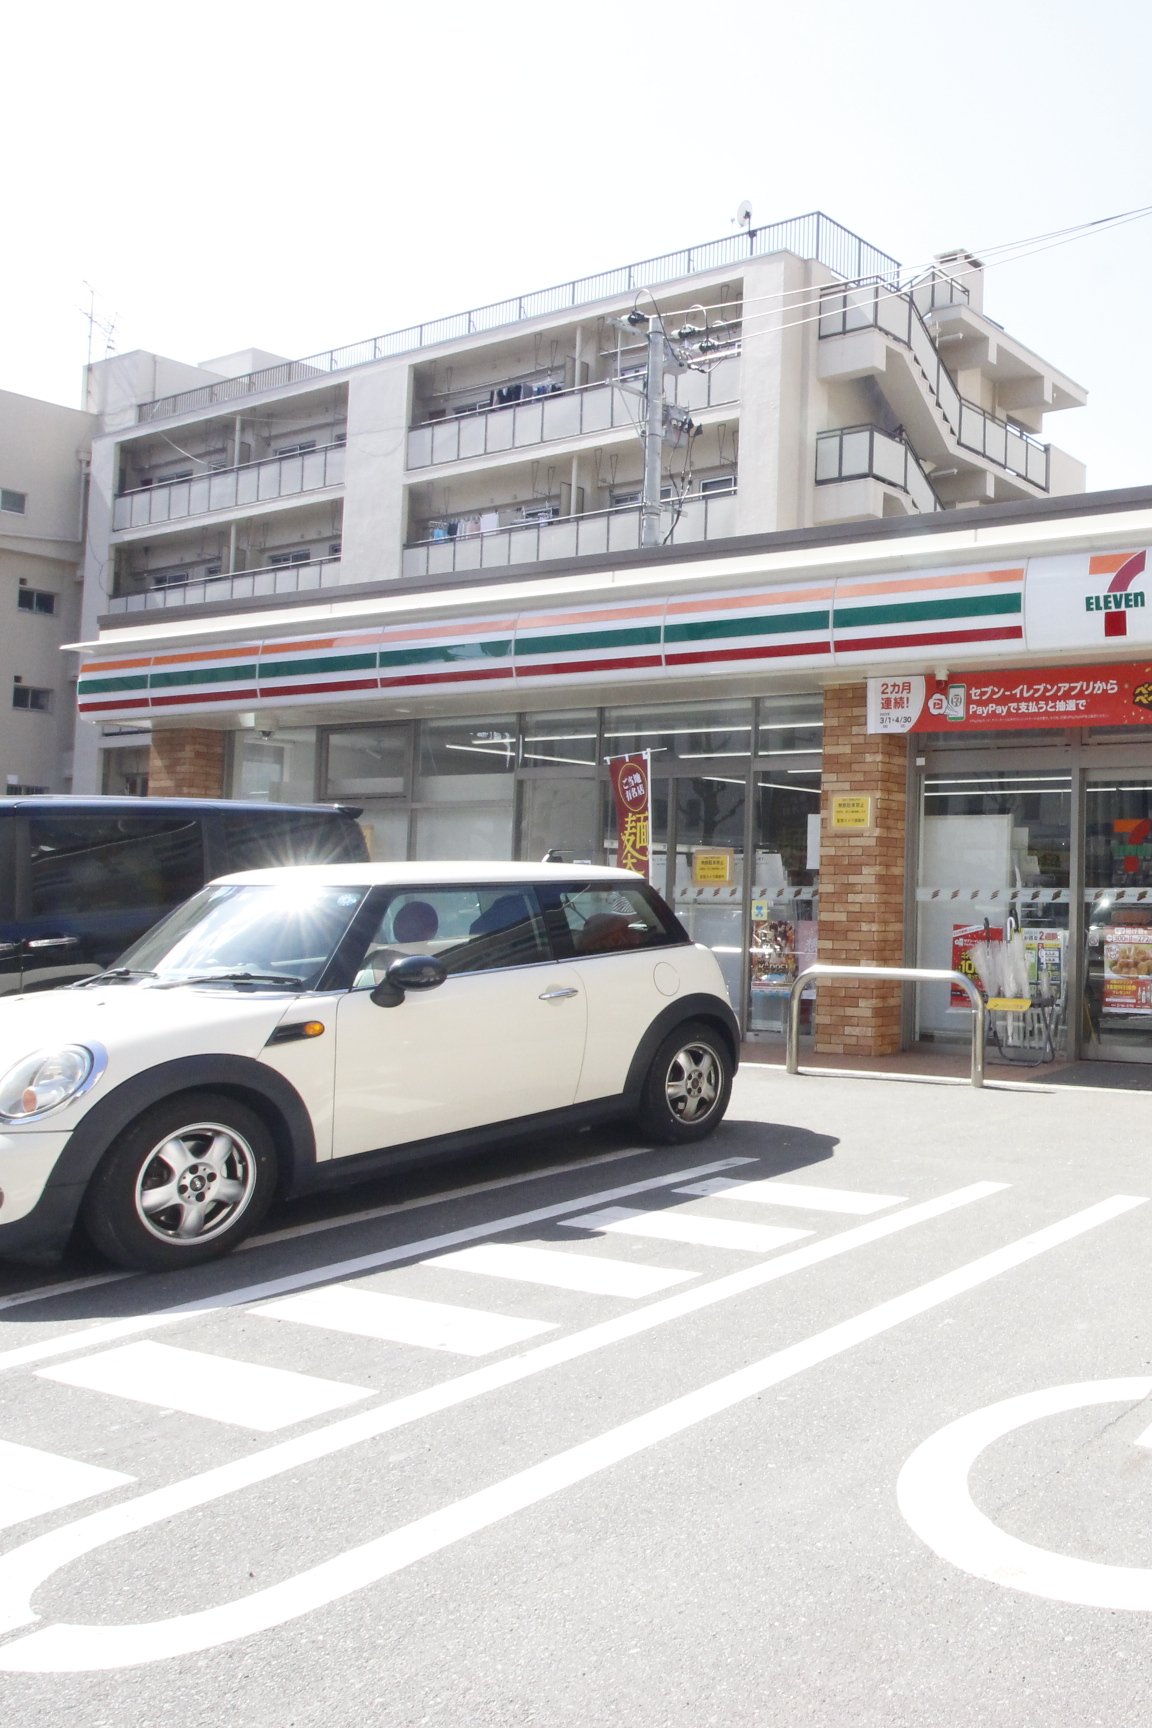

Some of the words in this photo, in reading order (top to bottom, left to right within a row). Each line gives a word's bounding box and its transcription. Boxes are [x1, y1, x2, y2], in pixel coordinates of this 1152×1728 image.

[1085, 591, 1146, 612] ELEVEN
[881, 682, 912, 695] 2カ月
[969, 699, 1086, 716] PayPayで支払うと抽選で
